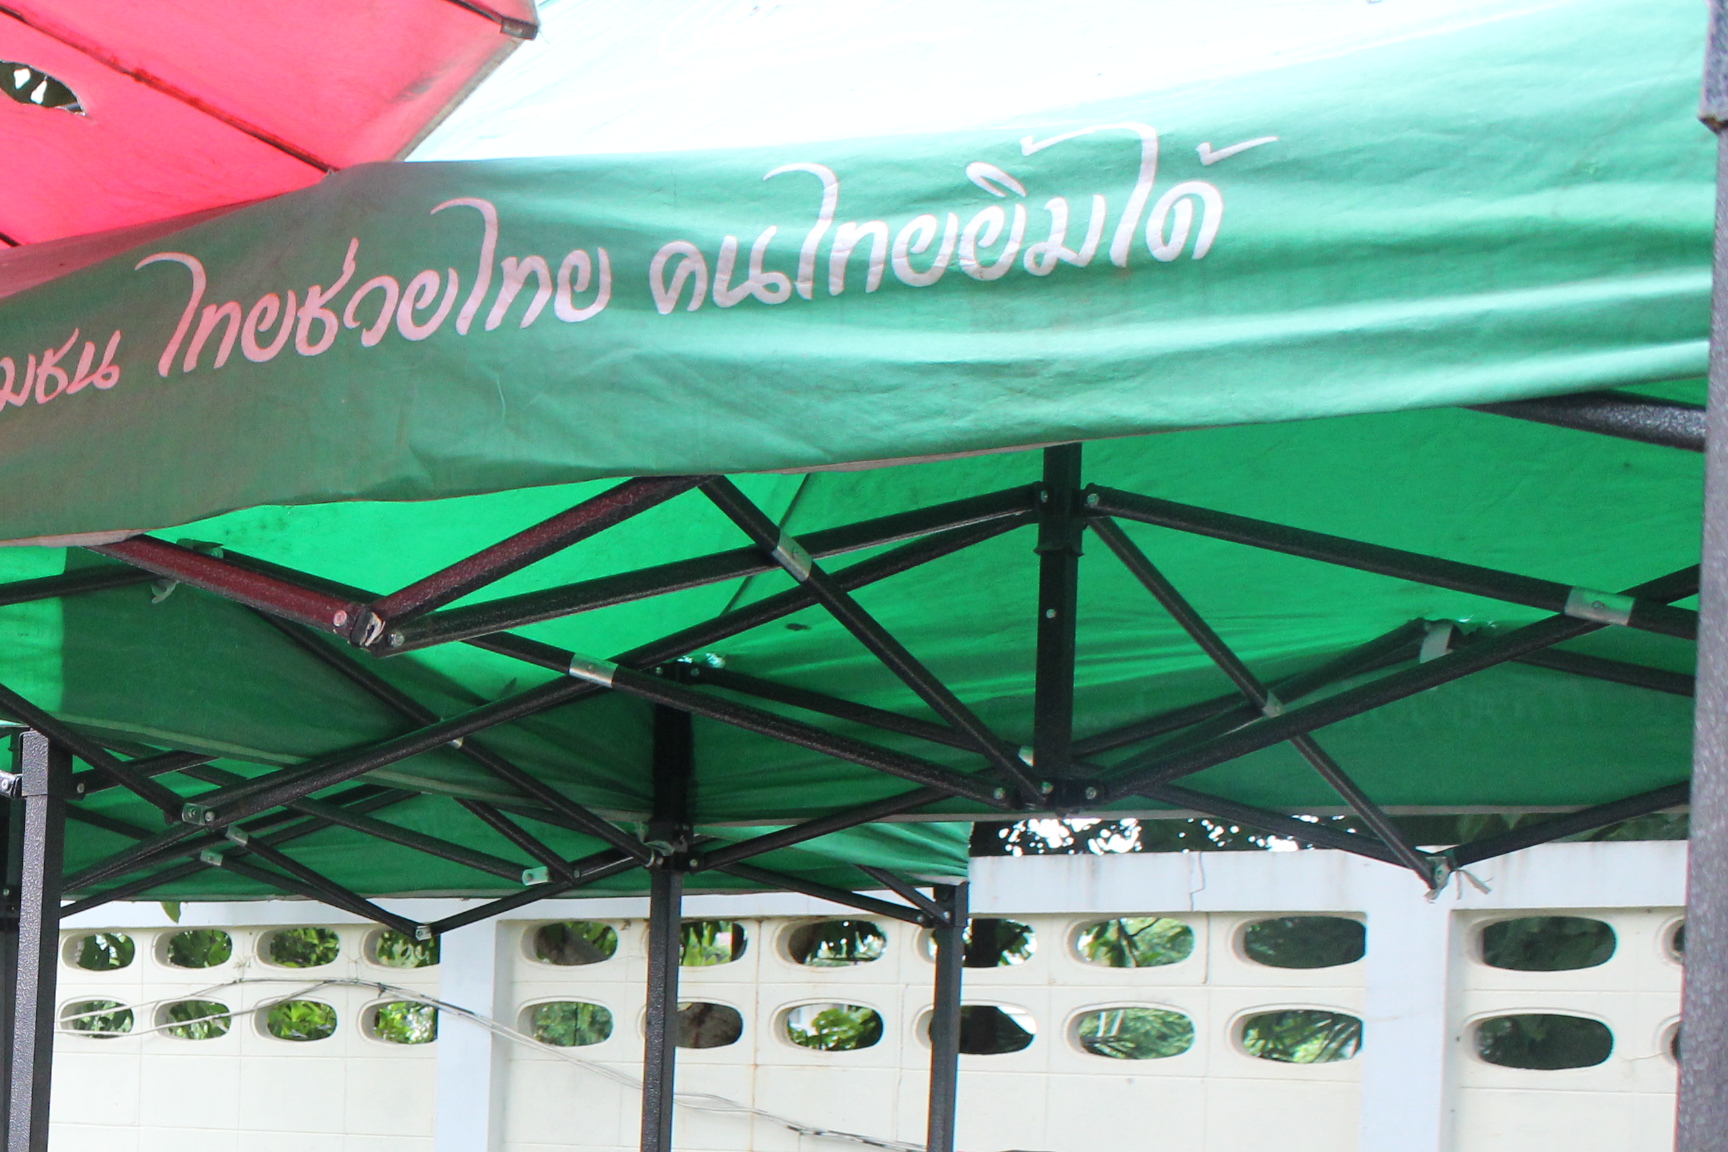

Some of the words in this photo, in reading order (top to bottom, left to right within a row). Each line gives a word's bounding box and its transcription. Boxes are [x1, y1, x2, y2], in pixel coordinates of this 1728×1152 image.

[133, 198, 612, 377] ไทยช่วยไทย
[648, 123, 1278, 315] คนไทยยิ้มได้
